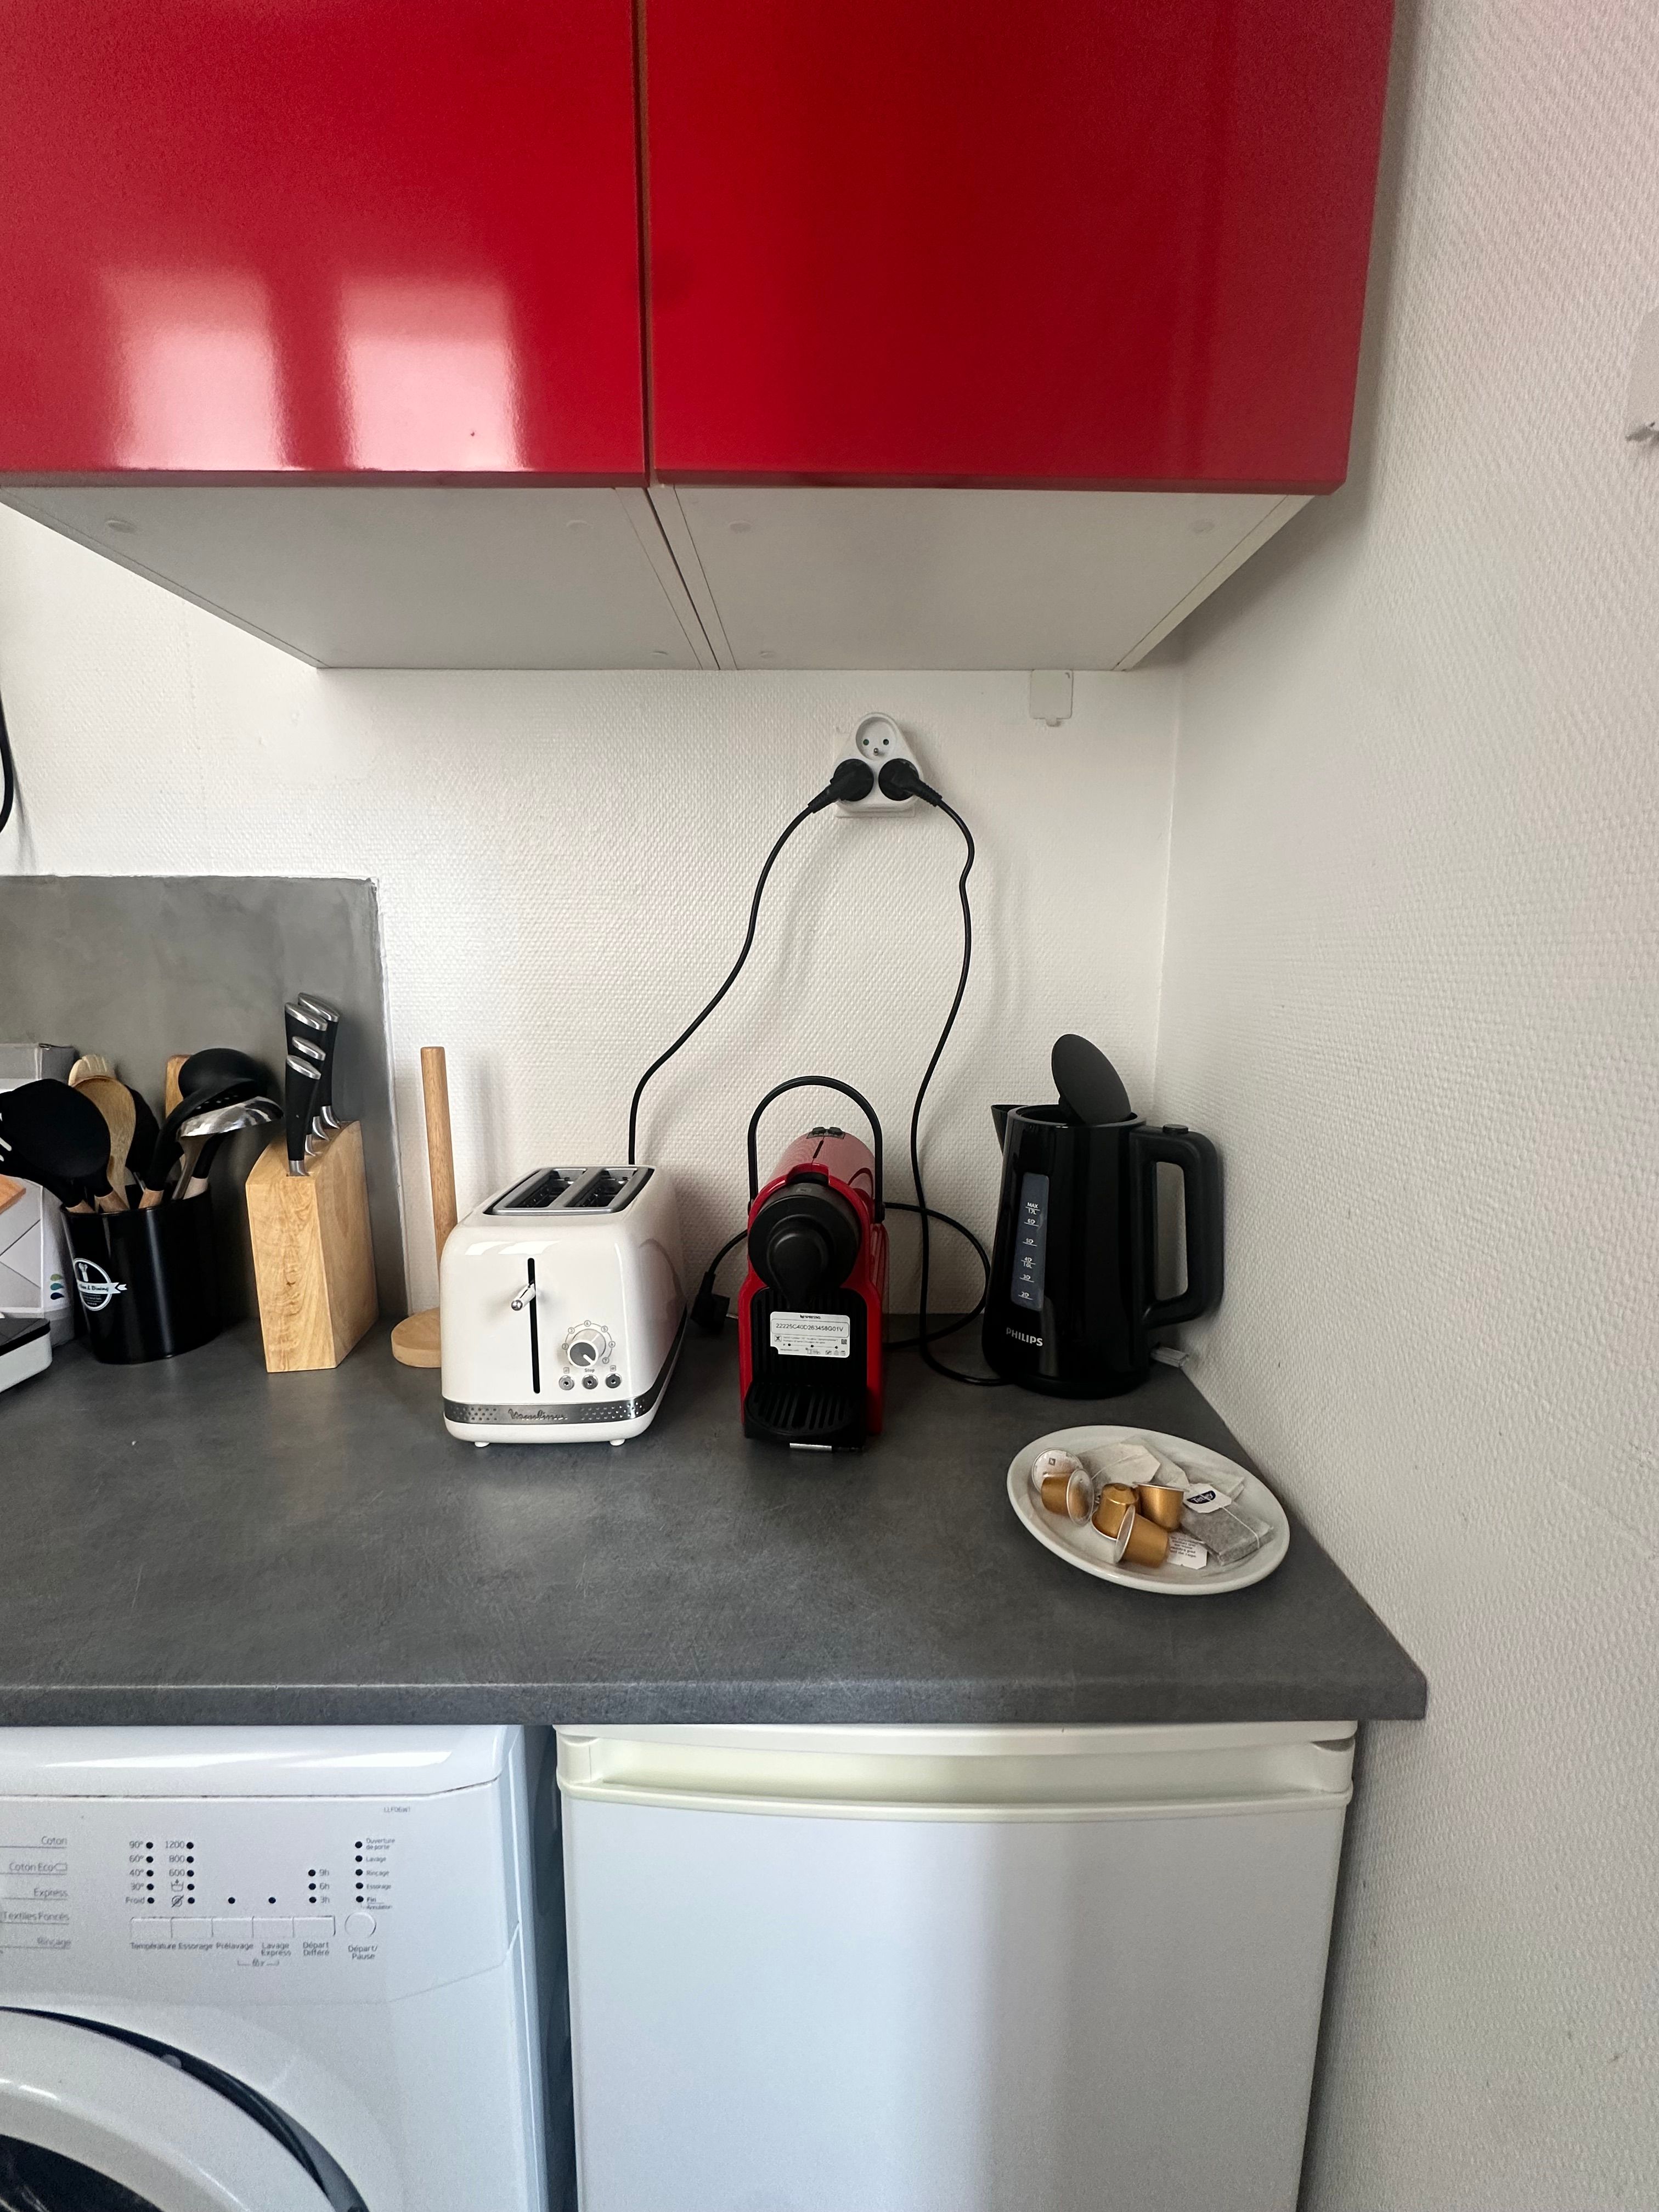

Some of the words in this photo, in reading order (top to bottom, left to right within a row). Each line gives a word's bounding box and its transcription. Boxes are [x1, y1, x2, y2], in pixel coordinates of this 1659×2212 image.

[1006, 1327, 1043, 1346] PHILIPS
[1190, 1492, 1214, 1503] Tetley
[41, 1836, 67, 1845] Coton
[9, 1862, 36, 1872] Coton
[34, 1888, 69, 1899] Express
[178, 1943, 213, 1951] Essorage
[216, 1942, 253, 1950] Prélavage
[303, 1941, 329, 1949] Départ
